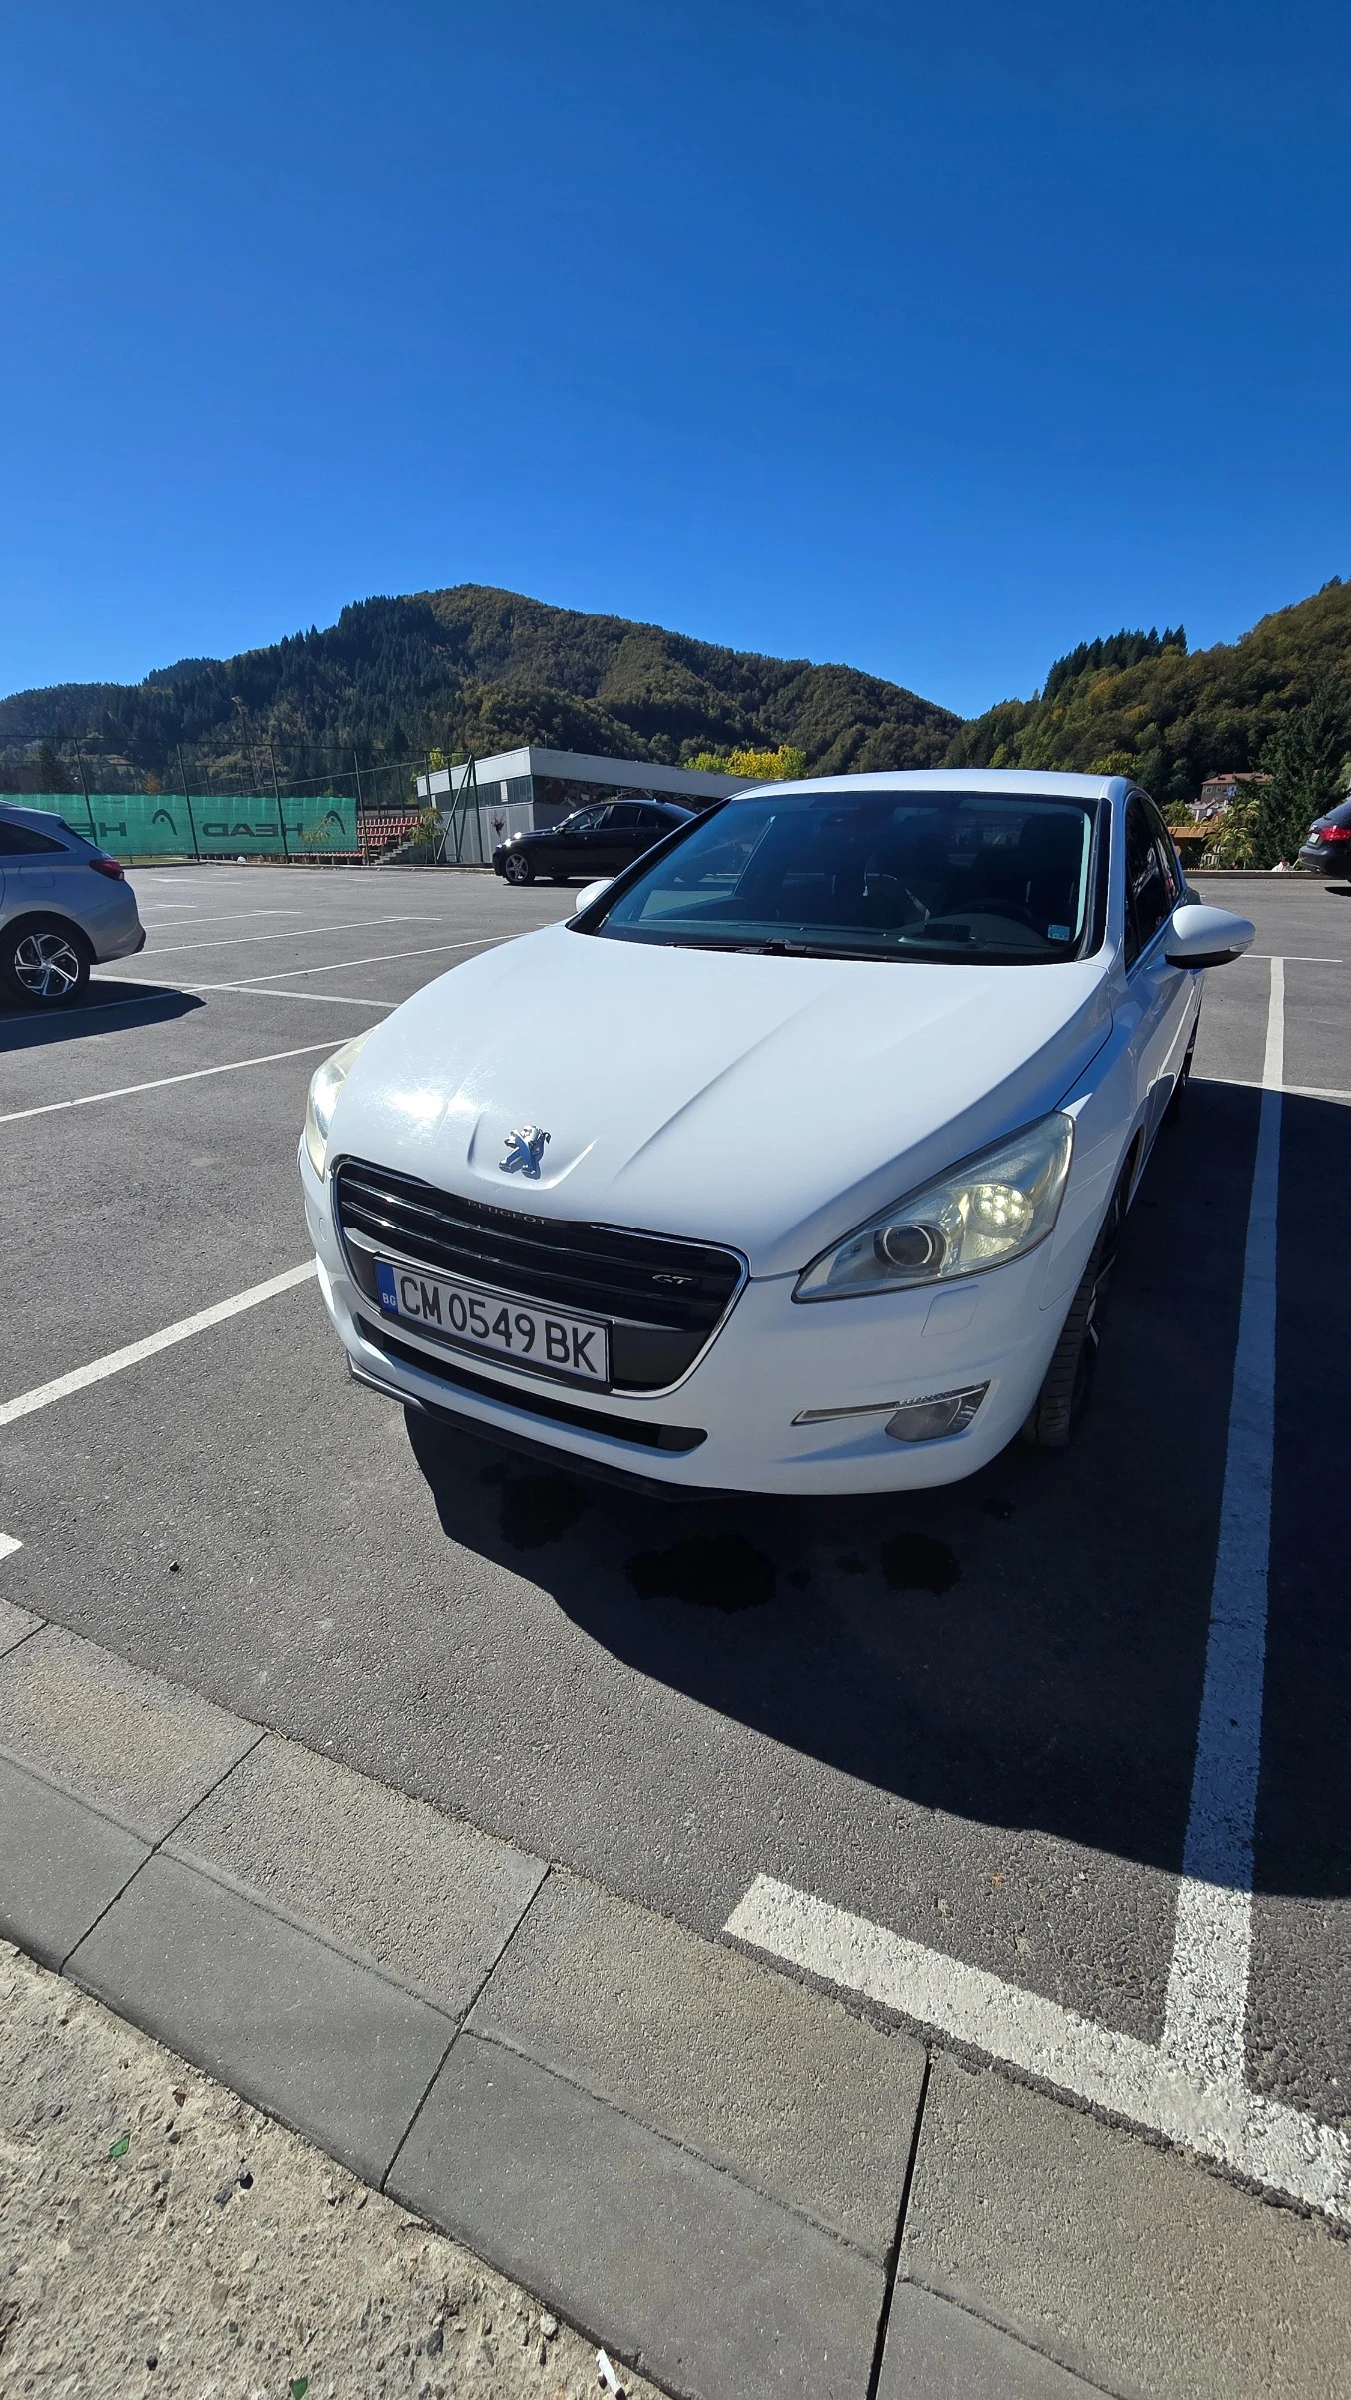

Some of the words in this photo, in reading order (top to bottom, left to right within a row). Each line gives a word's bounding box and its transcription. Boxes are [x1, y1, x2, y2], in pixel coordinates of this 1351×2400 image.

[382, 1292, 396, 1306] BG
[400, 1276, 442, 1325] CM
[448, 1293, 536, 1353] 0549
[545, 1319, 598, 1374] BK
